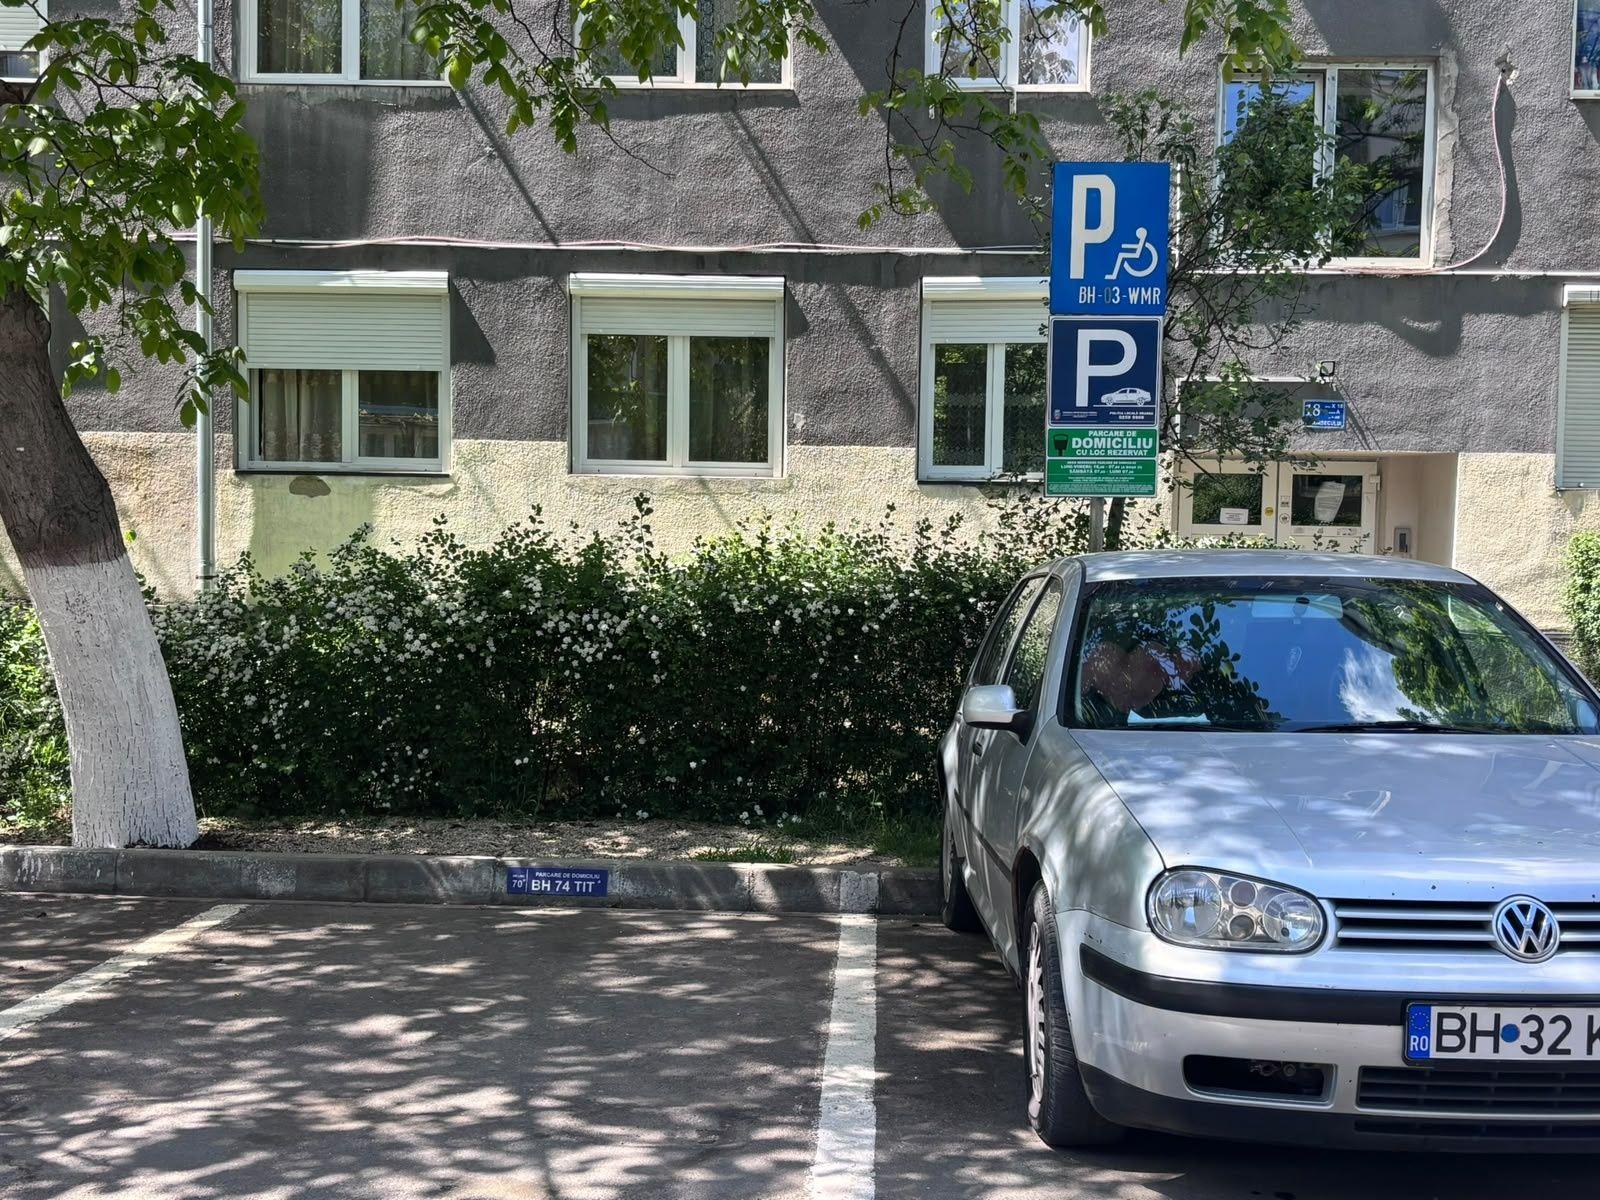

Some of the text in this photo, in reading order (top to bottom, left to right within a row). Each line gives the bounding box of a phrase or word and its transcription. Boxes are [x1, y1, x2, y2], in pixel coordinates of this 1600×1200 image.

[1070, 174, 1116, 280] P
[1076, 329, 1137, 407] P
[1072, 438, 1153, 449] DOMICILIU
[531, 880, 595, 892] BH 74 TIT
[1410, 1036, 1428, 1051] RO
[1436, 1012, 1500, 1054] BH
[1520, 1014, 1572, 1055] 32
